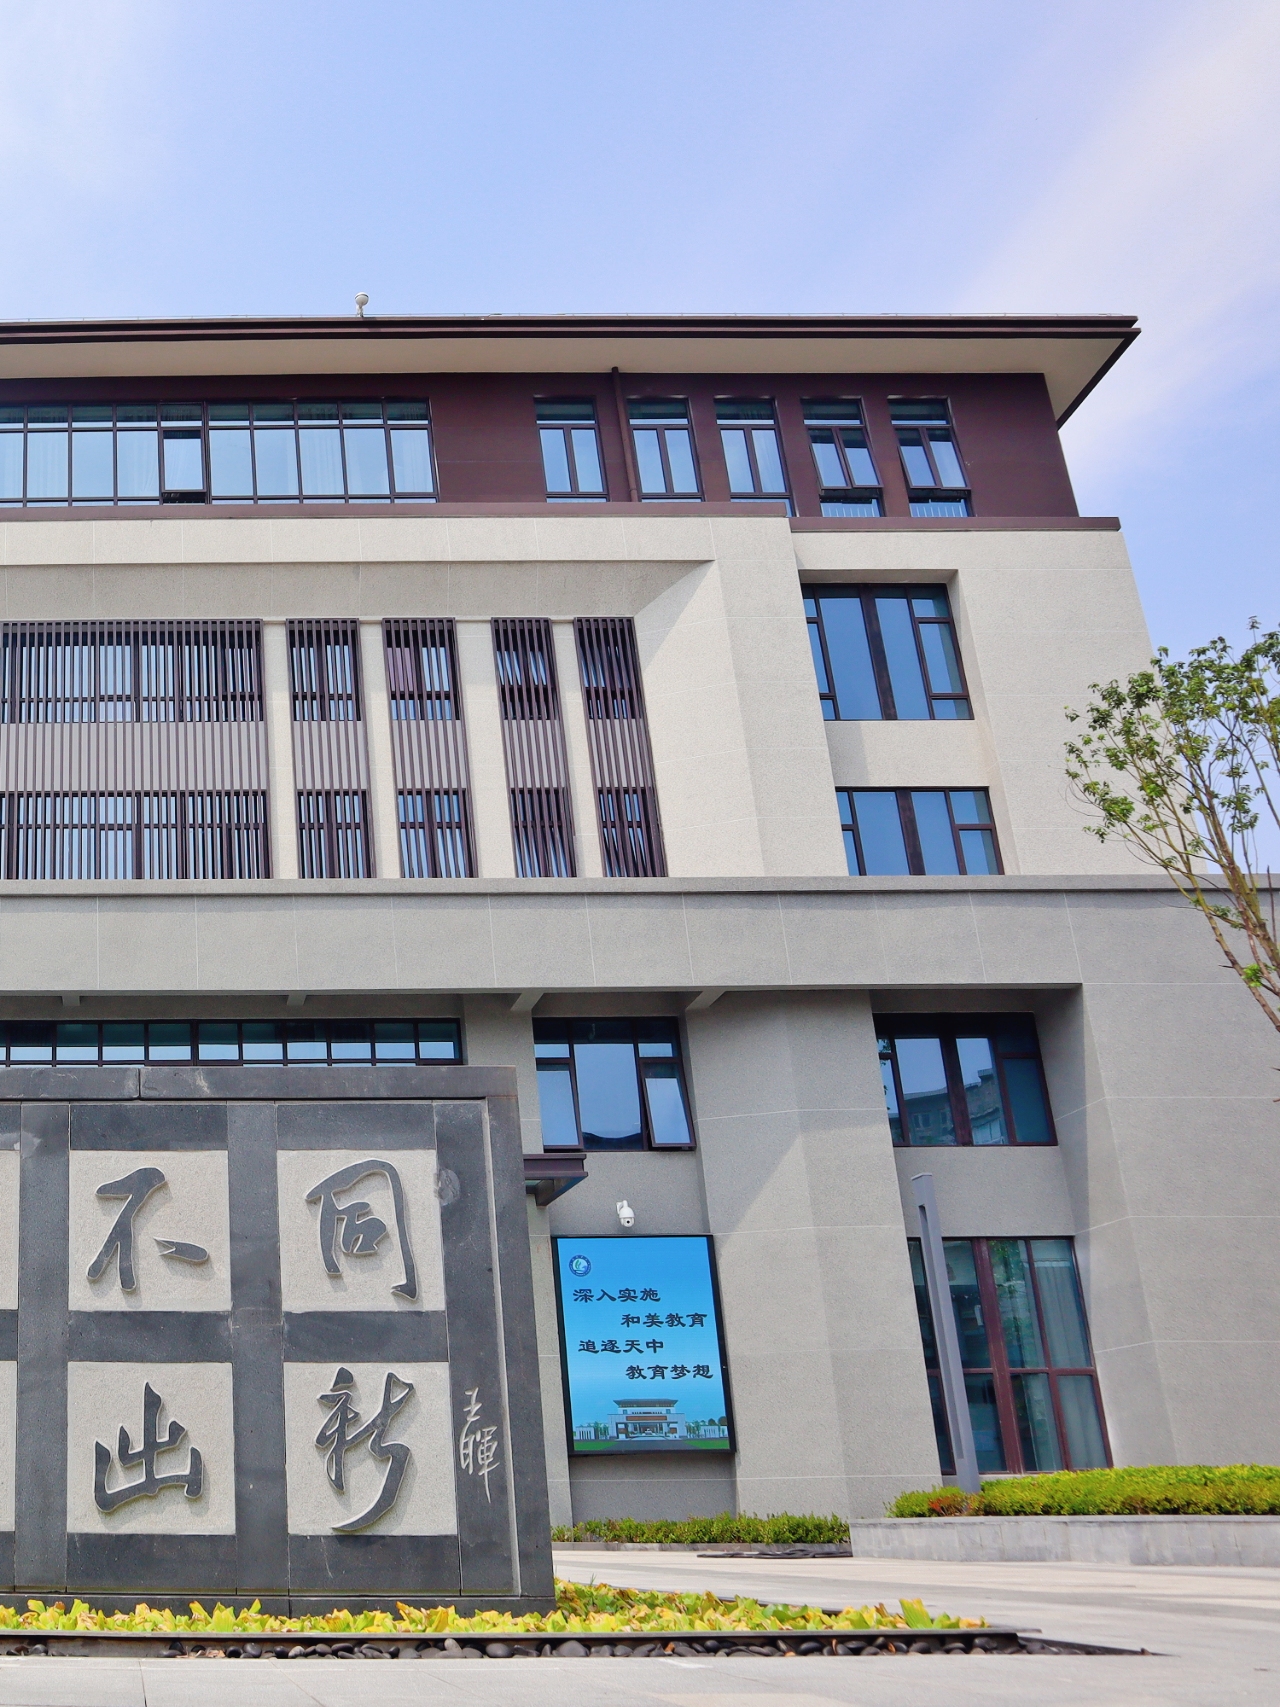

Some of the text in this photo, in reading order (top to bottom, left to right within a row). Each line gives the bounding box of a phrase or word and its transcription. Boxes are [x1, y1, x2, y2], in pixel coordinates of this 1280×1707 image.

[572, 1288, 661, 1303] 深入实施
[620, 1313, 708, 1328] 和美教育
[577, 1339, 664, 1354] 追逐天中
[625, 1364, 714, 1380] 教育梦想
